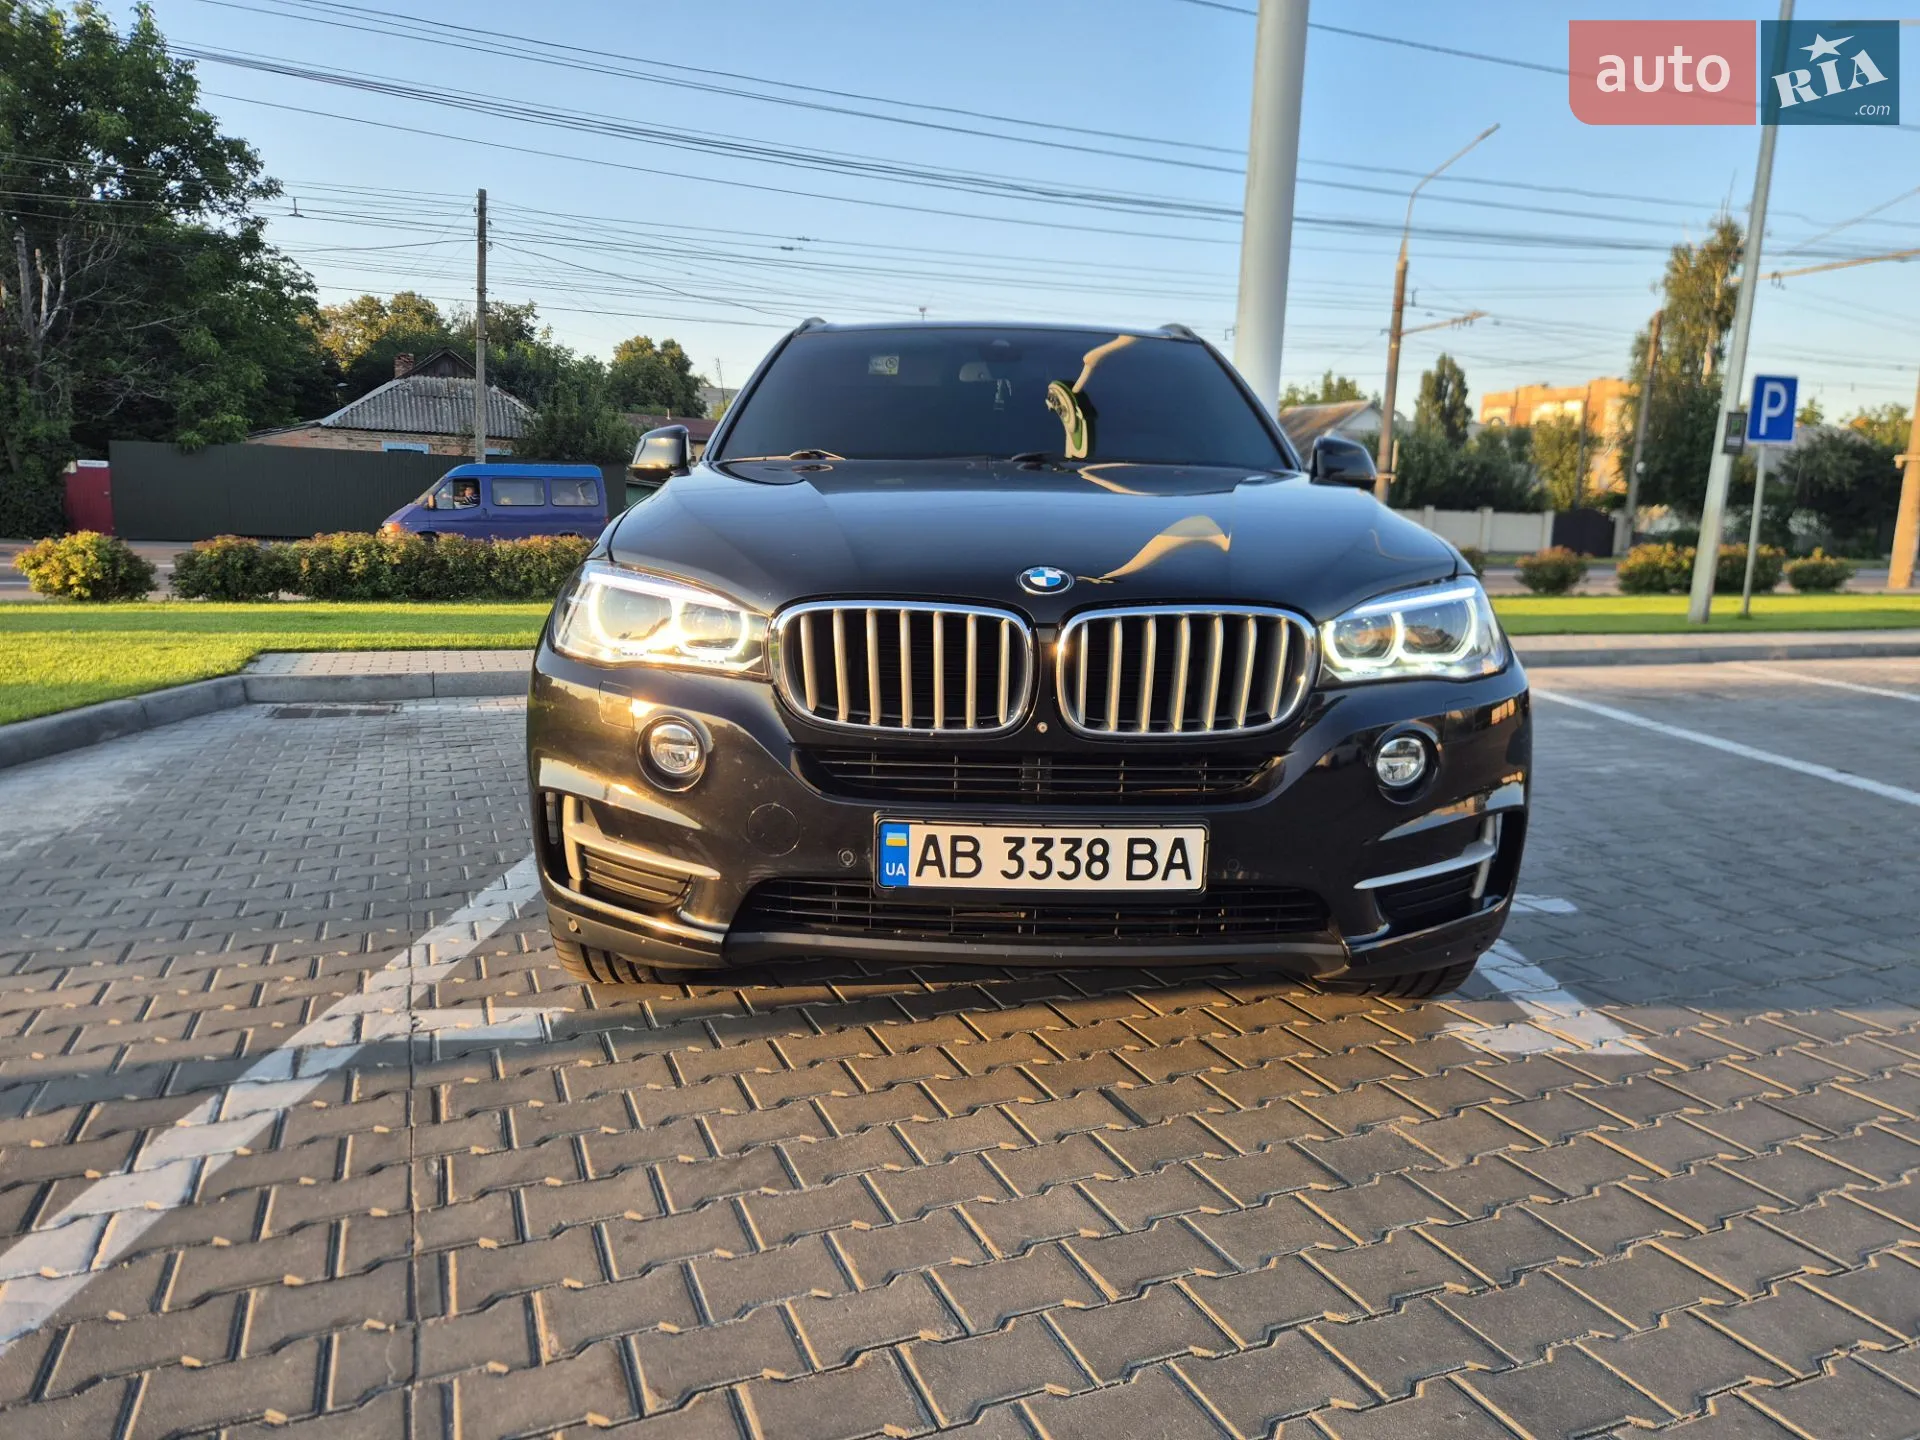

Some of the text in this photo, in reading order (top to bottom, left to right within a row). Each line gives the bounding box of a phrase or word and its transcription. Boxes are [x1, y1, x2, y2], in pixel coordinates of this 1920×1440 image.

[1759, 381, 1788, 436] P
[885, 862, 906, 877] UA
[915, 834, 1192, 881] AB 3338 BA
